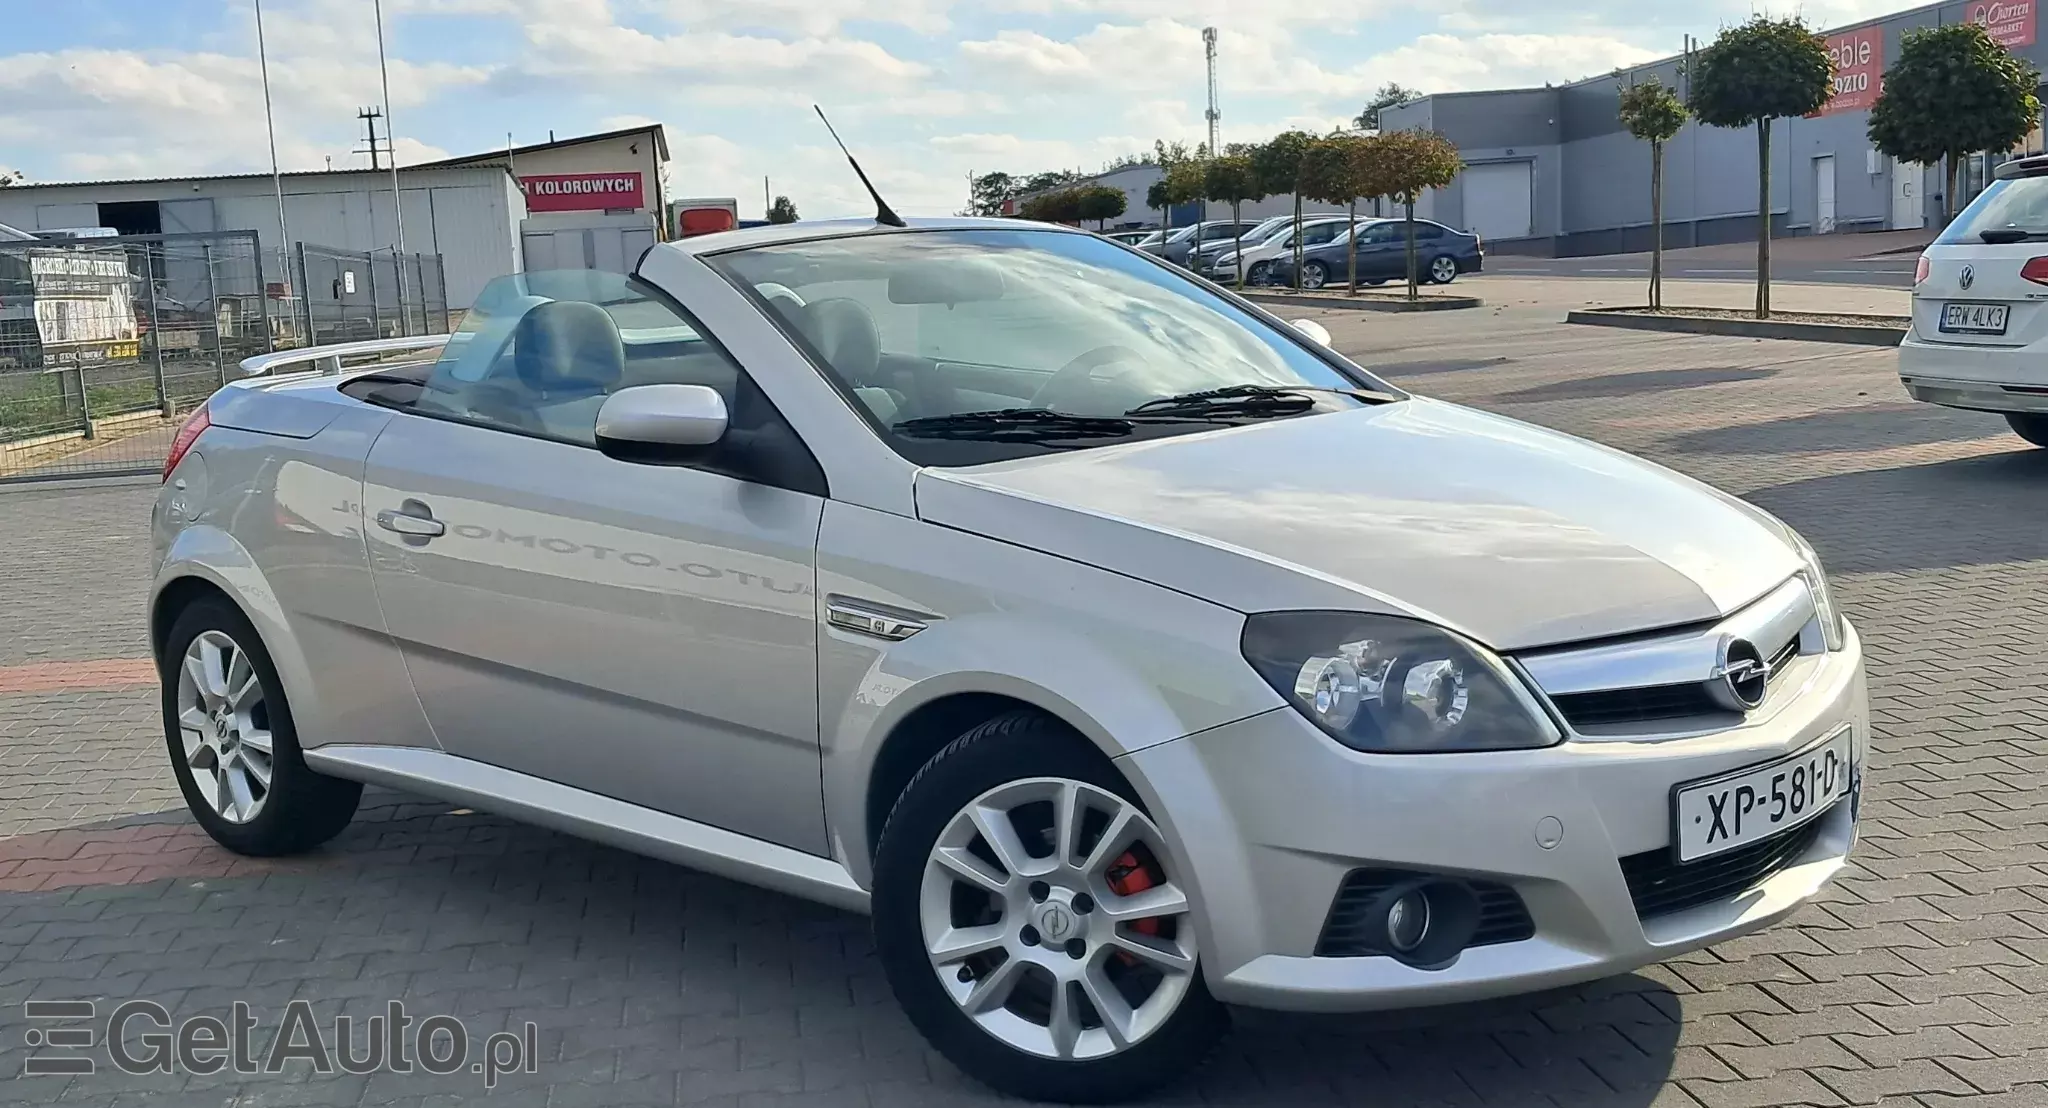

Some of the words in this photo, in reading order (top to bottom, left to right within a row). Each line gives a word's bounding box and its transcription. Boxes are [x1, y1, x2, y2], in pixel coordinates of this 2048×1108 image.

[1989, 21, 2024, 36] ERMARKET
[1829, 36, 1871, 70] eble
[1834, 72, 1868, 95] DZIO
[535, 178, 635, 196] KOLOROWYCH
[1947, 306, 1972, 326] ERW
[1972, 306, 2004, 328] 4LK3
